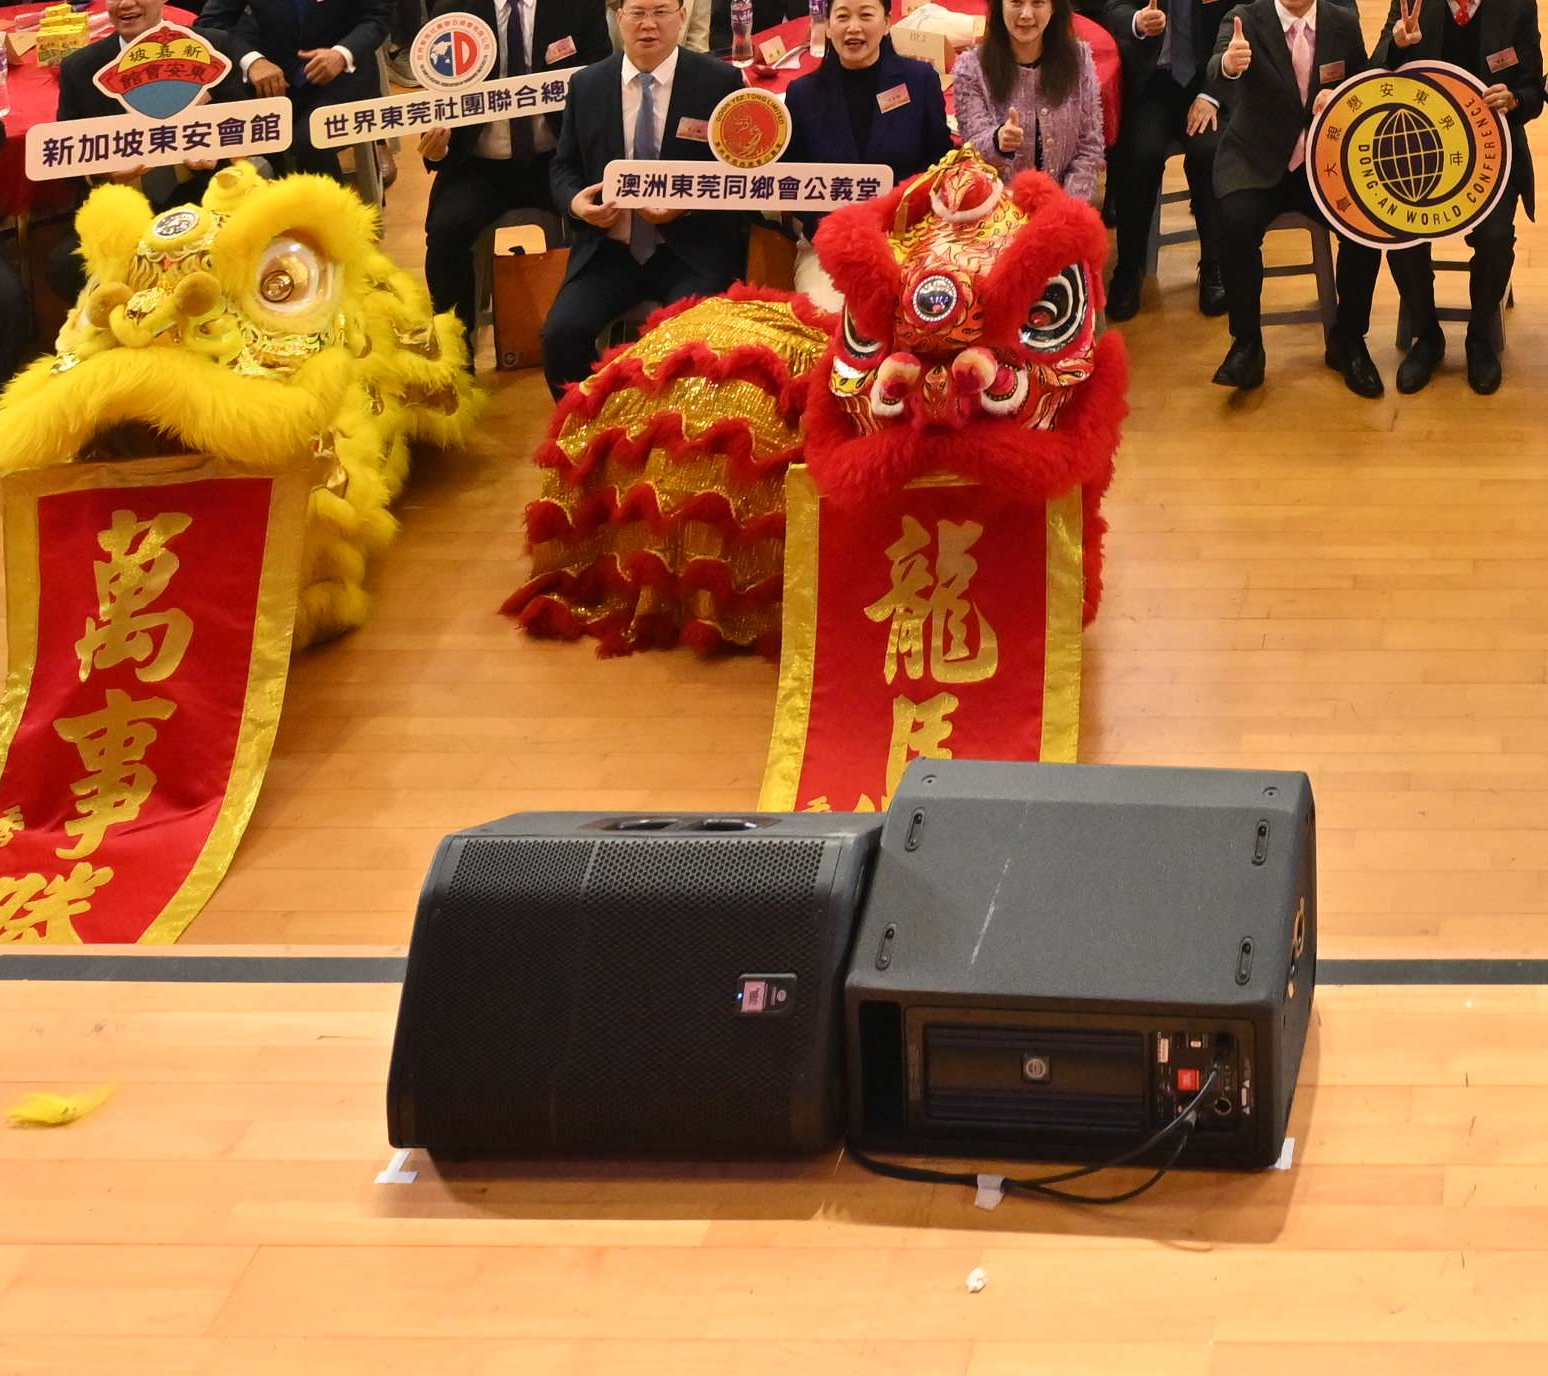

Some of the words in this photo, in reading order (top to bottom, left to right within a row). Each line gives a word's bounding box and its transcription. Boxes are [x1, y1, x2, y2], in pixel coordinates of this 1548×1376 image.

[324, 80, 570, 140] 世界東莞社團聯合總
[42, 112, 281, 168] 新加坡東安會館
[1406, 205, 1462, 225] WORLD
[1465, 98, 1496, 203] CONFERENCE
[616, 173, 881, 201] 澳洲東莞同鄉會公義堂
